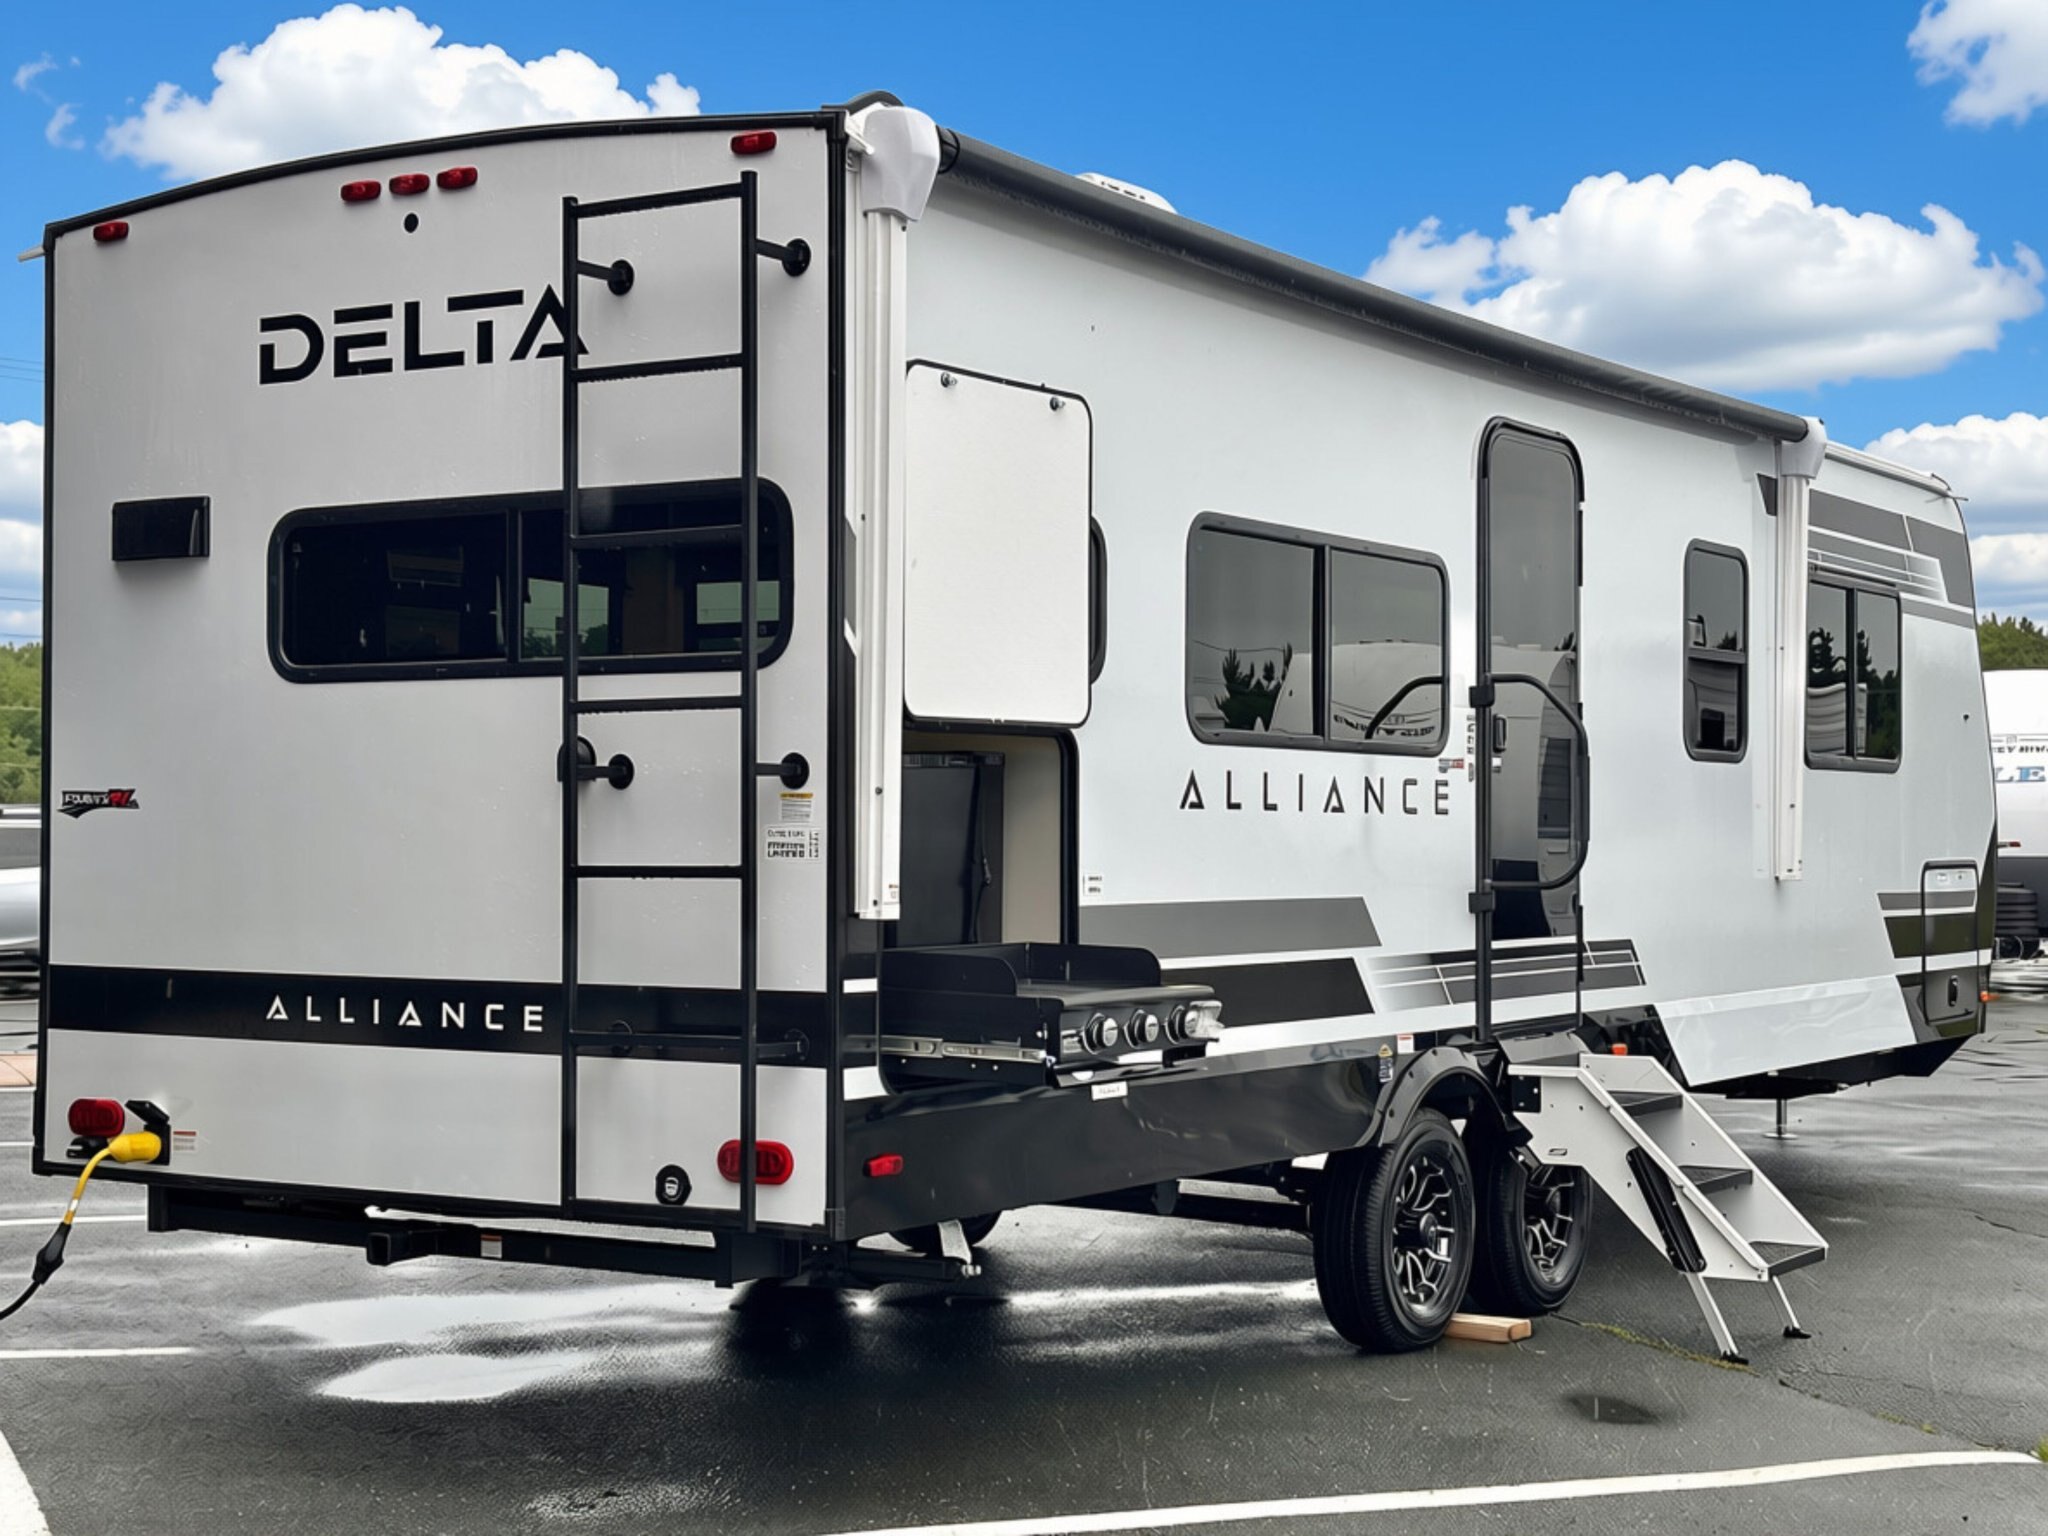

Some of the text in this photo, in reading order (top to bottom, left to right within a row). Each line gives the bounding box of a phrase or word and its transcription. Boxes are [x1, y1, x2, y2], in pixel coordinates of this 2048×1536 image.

[259, 284, 590, 385] DELTA
[1180, 769, 1450, 815] ALLIANCE
[265, 994, 544, 1033] ALLIANCE
